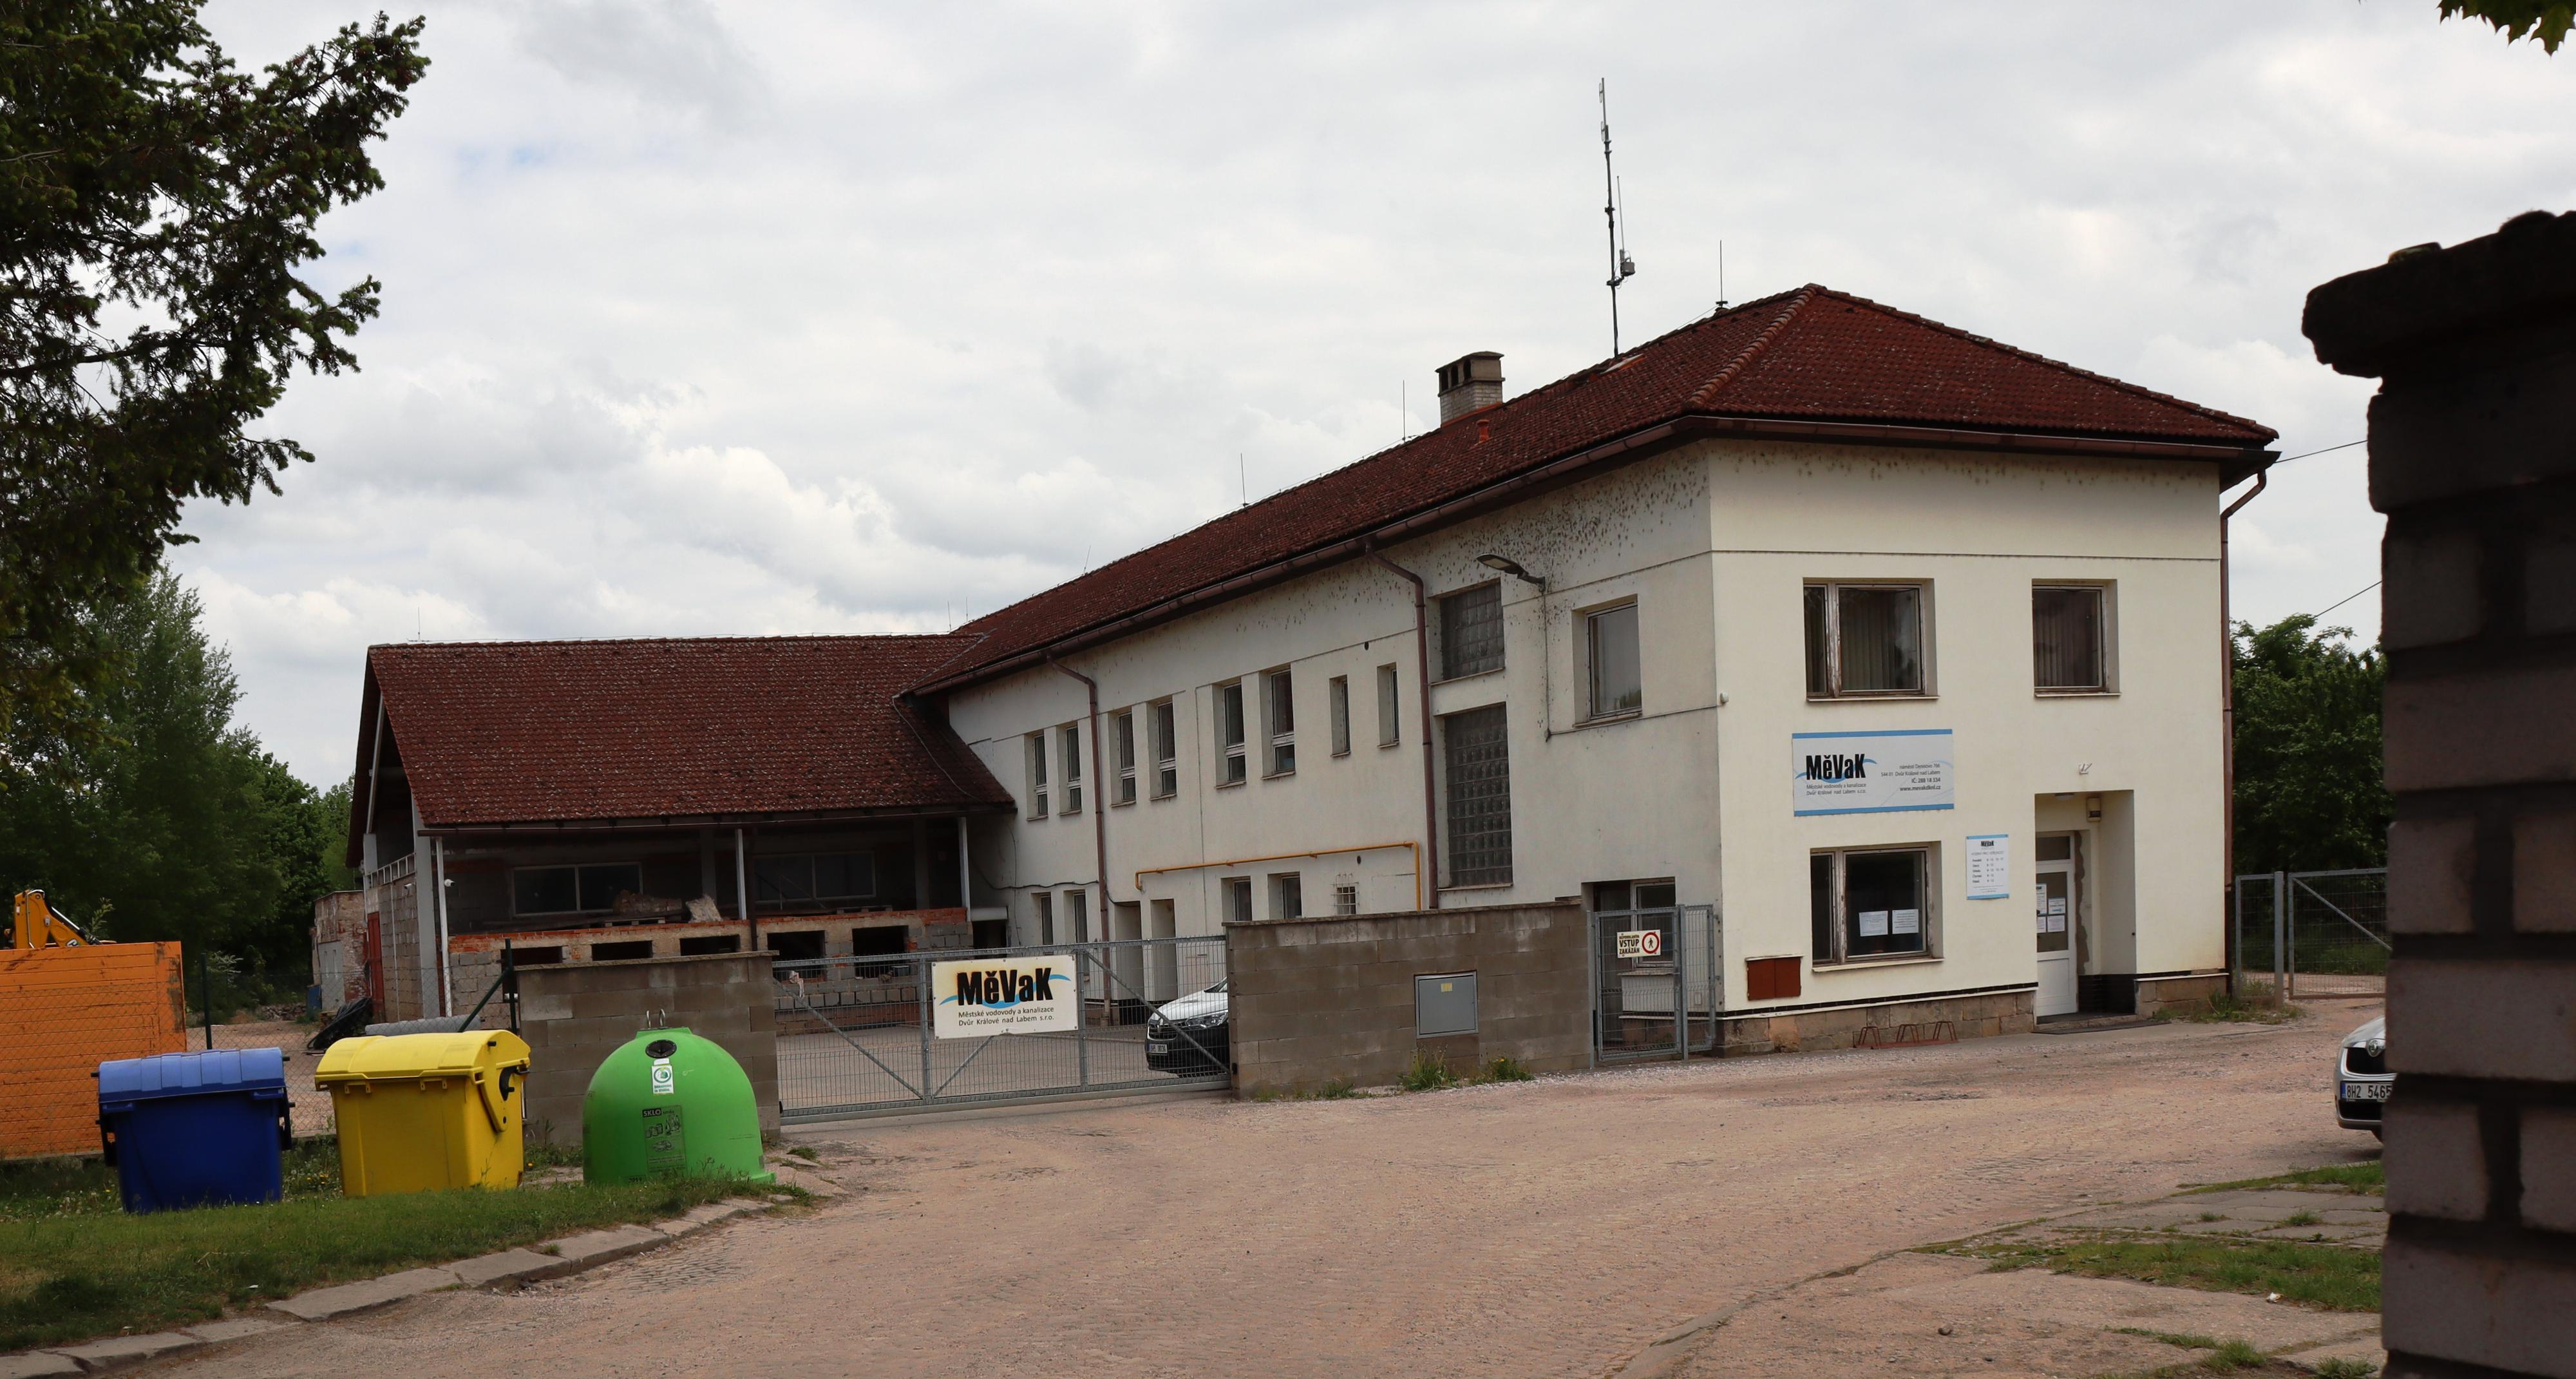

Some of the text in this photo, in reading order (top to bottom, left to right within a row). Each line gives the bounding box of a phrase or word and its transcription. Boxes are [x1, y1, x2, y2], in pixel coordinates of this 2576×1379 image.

[1806, 754, 1866, 780] MěVaK
[1619, 938, 1640, 947] VSTUP
[957, 967, 1054, 1005] MěVaK
[958, 1010, 984, 1018] Městské
[986, 1008, 1016, 1016] vodovody
[976, 1017, 999, 1025] Králové
[2347, 1085, 2361, 1098] 8H2
